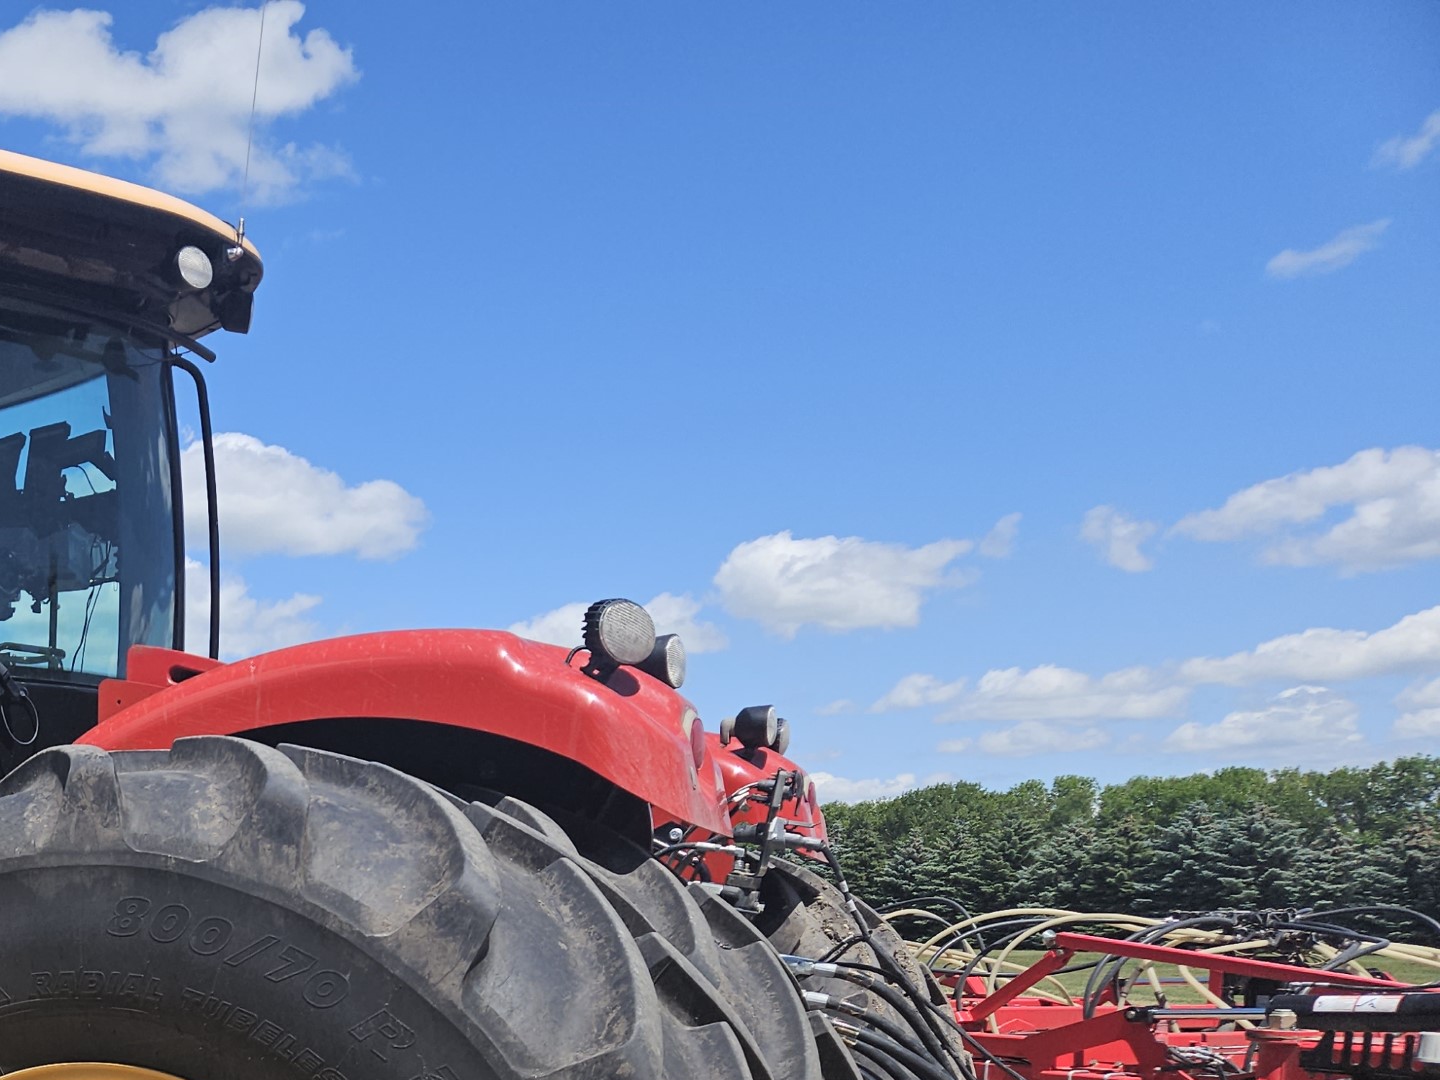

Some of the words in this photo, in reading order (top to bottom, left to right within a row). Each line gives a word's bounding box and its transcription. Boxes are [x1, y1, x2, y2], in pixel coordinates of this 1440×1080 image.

[30, 971, 164, 1002] RADIAL
[107, 896, 350, 1009] 800/70
[350, 1011, 415, 1061] R
